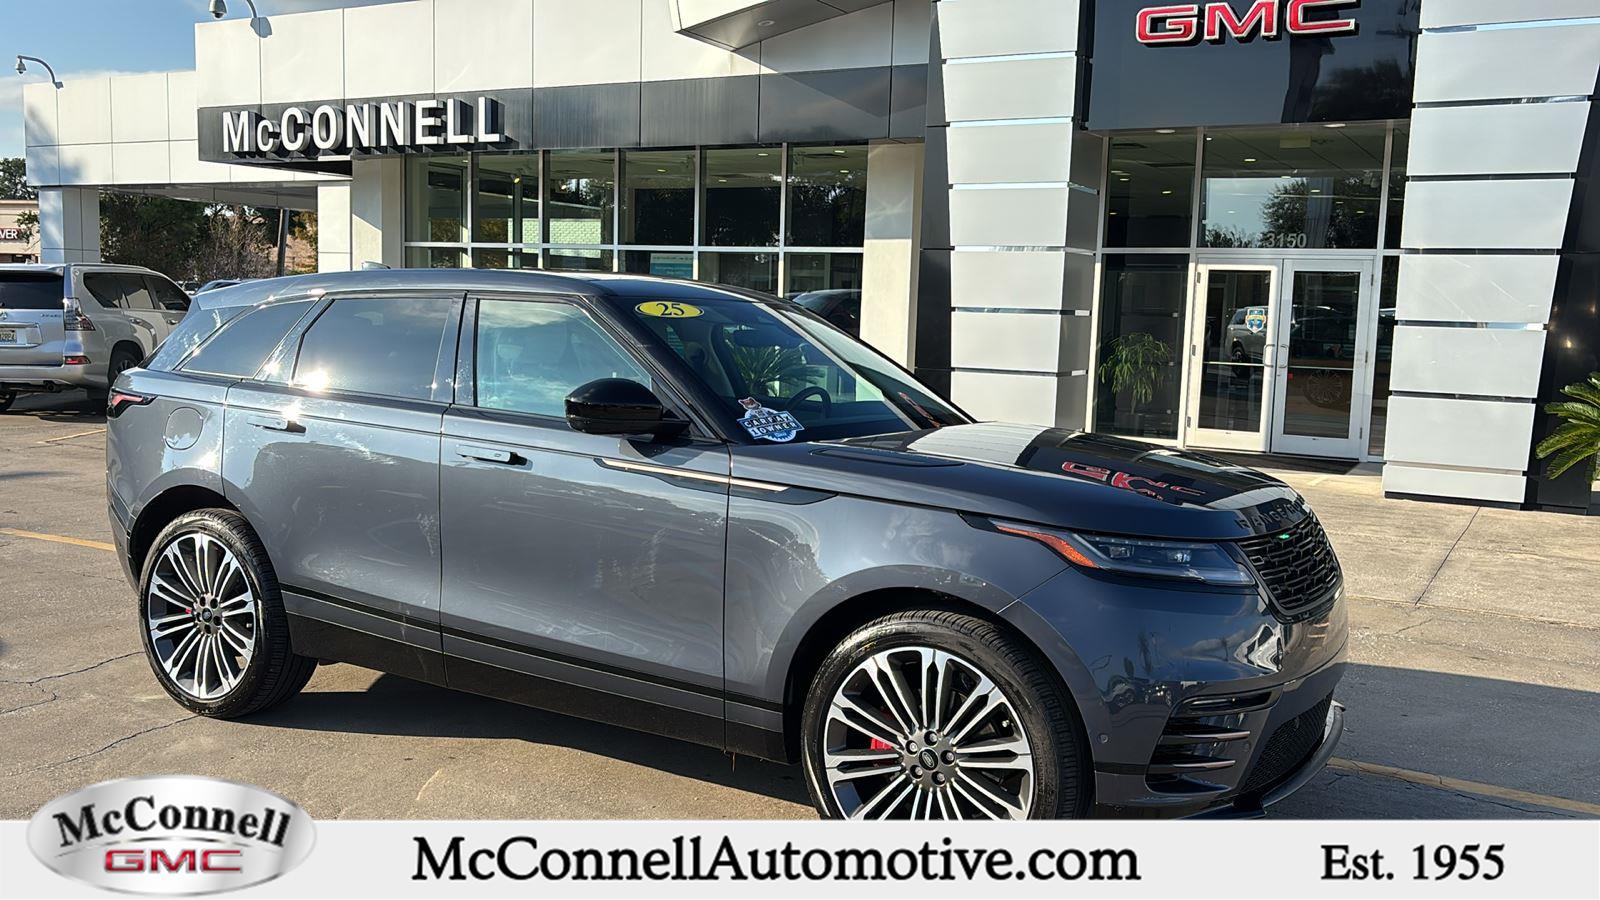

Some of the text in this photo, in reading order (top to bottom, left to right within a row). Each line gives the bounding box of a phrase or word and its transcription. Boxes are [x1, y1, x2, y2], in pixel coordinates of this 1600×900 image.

[1136, 0, 1355, 43] GMC
[222, 96, 503, 152] McCONNELL
[1266, 232, 1307, 248] 3150
[656, 302, 685, 316] 25
[744, 413, 793, 428] CARFAX
[760, 421, 798, 434] OWNER
